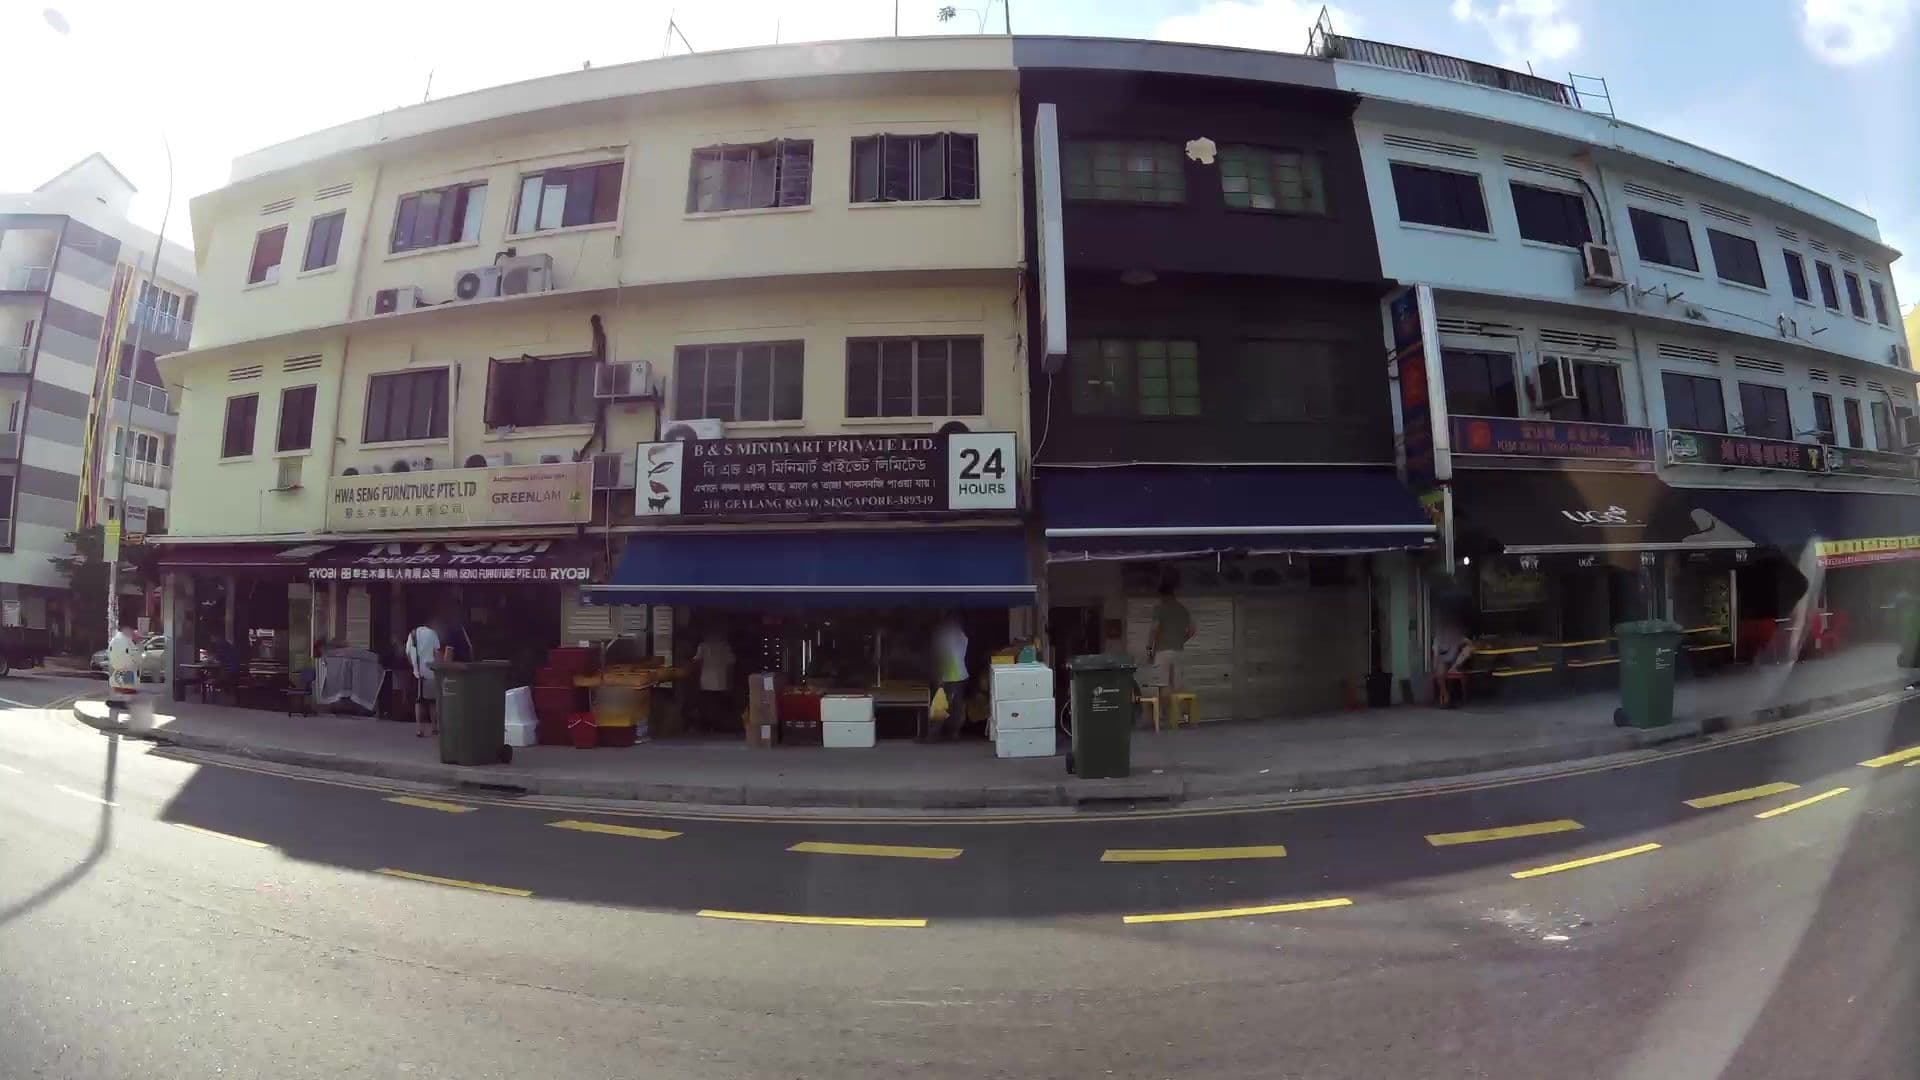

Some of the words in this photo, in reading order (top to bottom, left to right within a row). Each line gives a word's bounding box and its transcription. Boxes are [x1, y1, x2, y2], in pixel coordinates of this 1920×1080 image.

[694, 443, 703, 456] B
[707, 443, 722, 456] &
[724, 443, 733, 456] S
[737, 440, 823, 455] MINIMART
[827, 437, 897, 453] PRIVATE
[901, 437, 937, 451] LTD.
[746, 461, 767, 476] এস
[875, 455, 926, 472] লিমিটেড
[959, 447, 1006, 480] 24
[335, 487, 354, 503] HWA
[356, 486, 380, 502] SENG
[382, 482, 434, 500] FURNITURE
[437, 481, 455, 498] PTE
[457, 480, 477, 497] LTD
[492, 489, 561, 504] GREENLAM
[958, 483, 1006, 496] HOURS
[725, 498, 781, 509] GEYLANG
[447, 553, 537, 564] TOOLS
[308, 567, 337, 579] RYOBI
[550, 567, 590, 580] RYOBI
